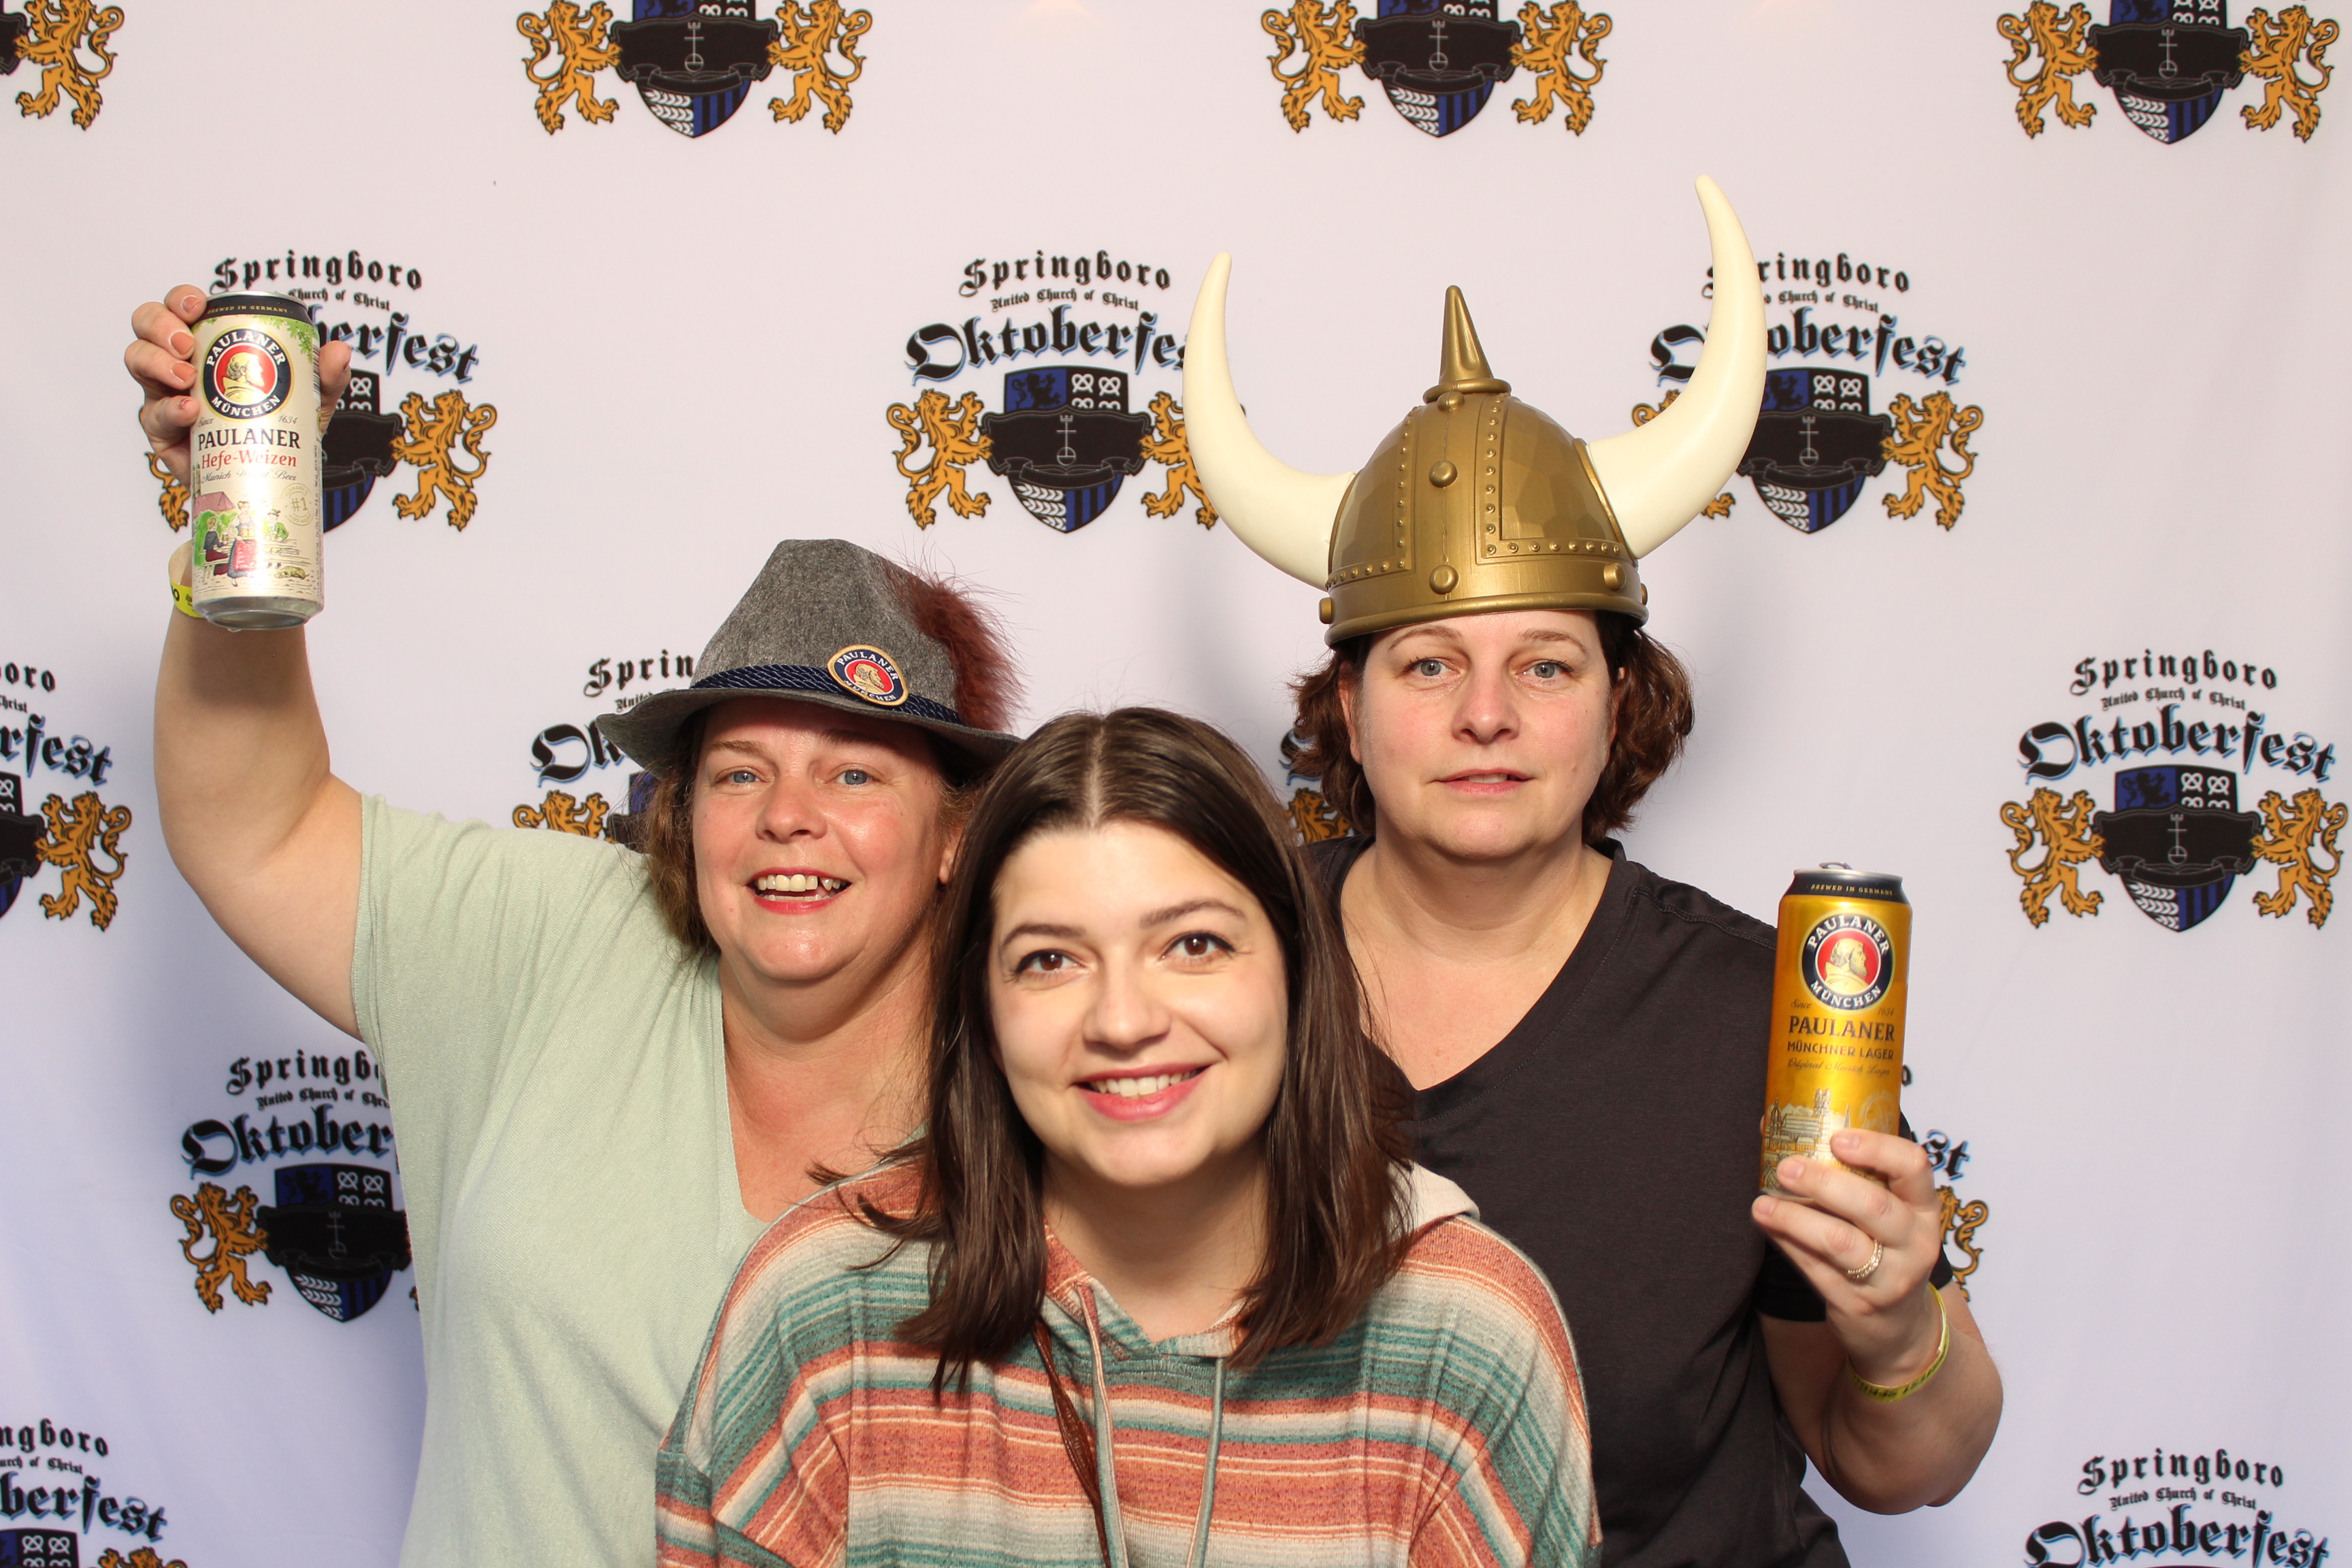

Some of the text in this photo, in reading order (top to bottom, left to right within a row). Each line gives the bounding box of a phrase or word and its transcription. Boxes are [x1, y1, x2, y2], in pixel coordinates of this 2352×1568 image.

[209, 249, 422, 295] Springboro
[958, 249, 1171, 297] Springboro
[1702, 252, 1910, 298] ringboro
[207, 306, 235, 314] BREWED
[250, 305, 288, 313] GERMANY
[336, 289, 346, 300] of
[354, 292, 391, 311] Christ
[990, 288, 1139, 312] United Church of Christ
[1779, 290, 1818, 304] Church
[1825, 292, 1835, 303] of
[1843, 294, 1879, 313] Christ
[206, 330, 287, 367] PAULANER
[904, 304, 1188, 387] Oktoberfe
[1649, 306, 1966, 387] Ooberfest
[212, 395, 281, 417] MÜNCHEN
[278, 414, 298, 425] 1634
[198, 428, 301, 451] PAULANER
[201, 449, 297, 471] Hefe-Weizen
[201, 470, 231, 484] Munich
[275, 470, 297, 481] Beer
[291, 496, 309, 512] #1
[836, 651, 899, 681] PAULANER
[2070, 649, 2278, 696] Springboro
[2101, 687, 2246, 711] United Church of Christ
[2017, 704, 2335, 785] Oktoberfest
[1859, 887, 1893, 896] GERMANY
[1808, 914, 1889, 956] PAULANER
[1810, 980, 1881, 1008] MÜNCHEN
[1791, 998, 1895, 1017] Since 1634
[1788, 1015, 1895, 1042] PAULANER
[1787, 1040, 1894, 1060] MÜNCHNER LAGER
[227, 1049, 379, 1095] Springb
[1788, 1057, 1824, 1071] Original
[1825, 1061, 1864, 1073] Munich
[1865, 1064, 1891, 1079] Lager
[256, 1090, 293, 1110] United
[299, 1087, 338, 1102] Church
[344, 1089, 355, 1100] of
[182, 1103, 399, 1180] Oktober
[29, 1456, 40, 1467] of
[48, 1457, 83, 1475] Christ
[2078, 1448, 2283, 1495] Springboro
[2108, 1487, 2257, 1511] United Church of Christ
[2023, 1503, 2329, 1568] Oktoberfest
